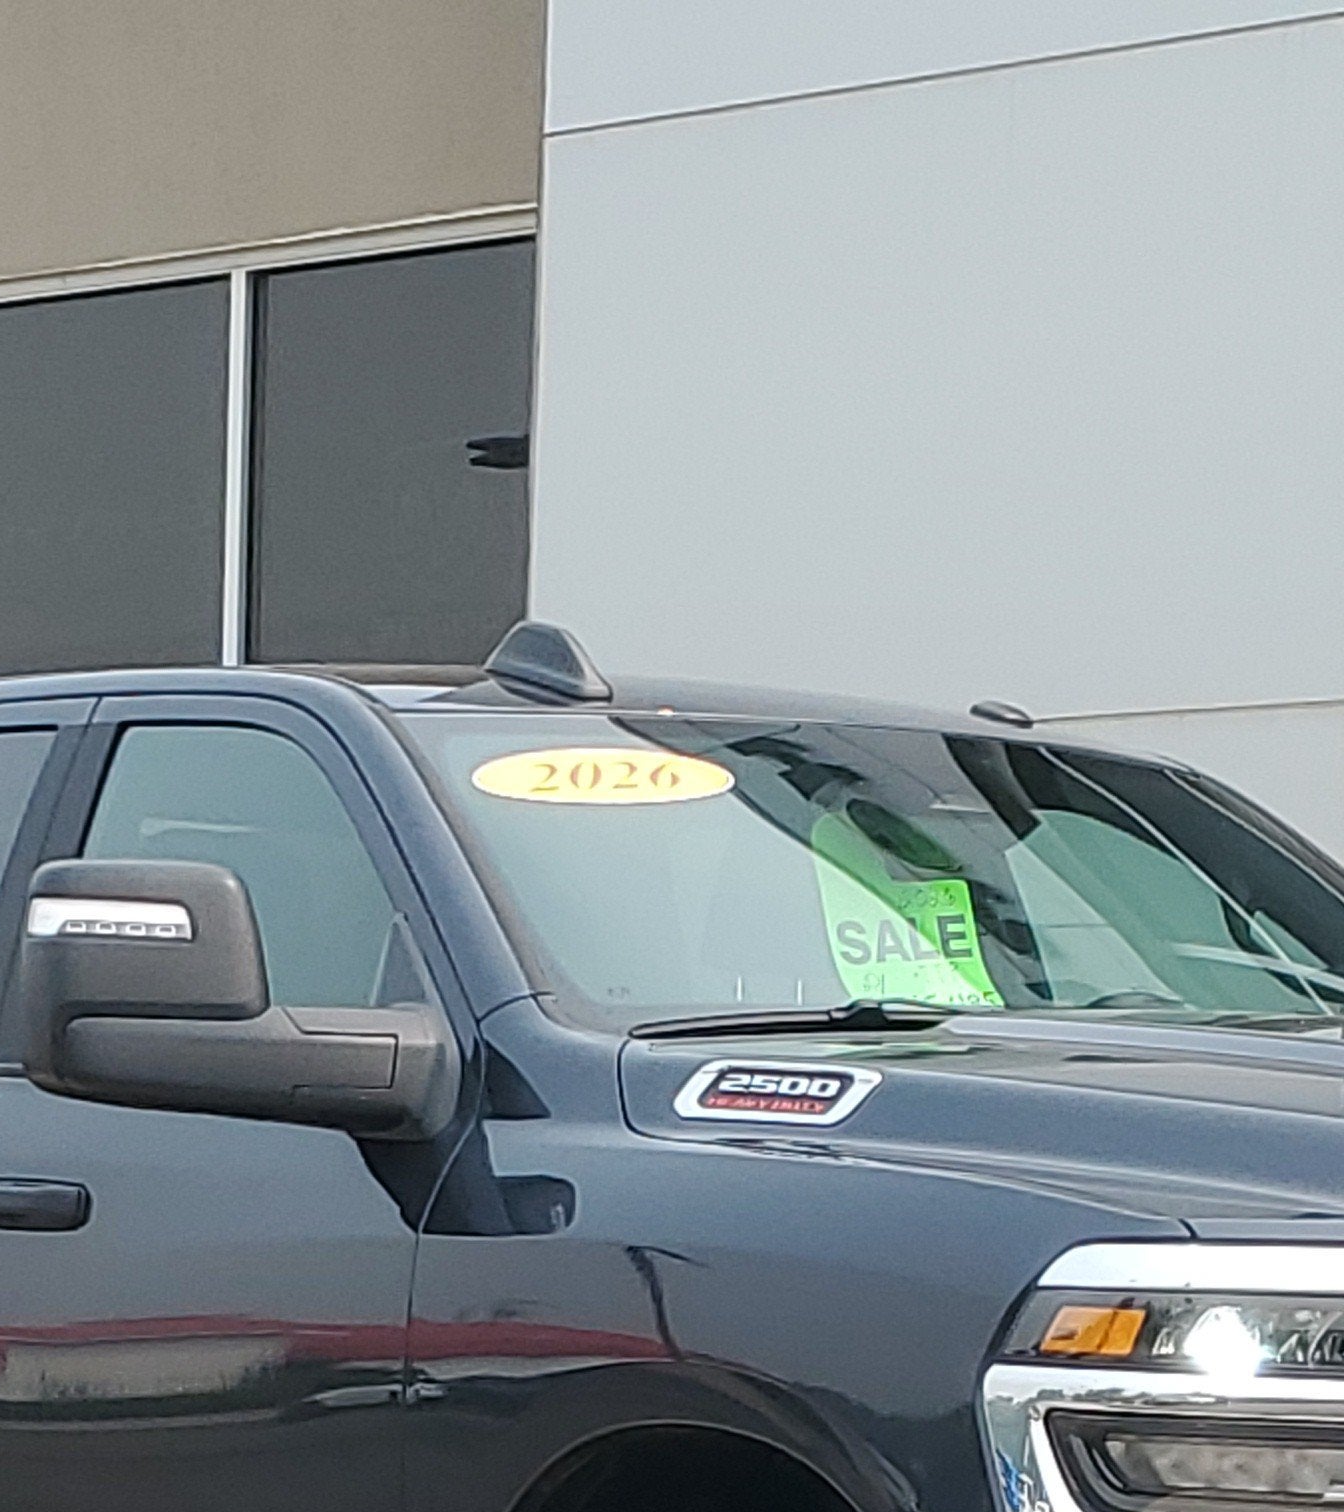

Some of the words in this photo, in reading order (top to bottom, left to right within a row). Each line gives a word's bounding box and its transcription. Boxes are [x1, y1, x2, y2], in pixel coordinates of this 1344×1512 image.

[530, 761, 681, 793] 2026
[835, 913, 974, 966] SALE
[718, 1073, 842, 1098] 2500
